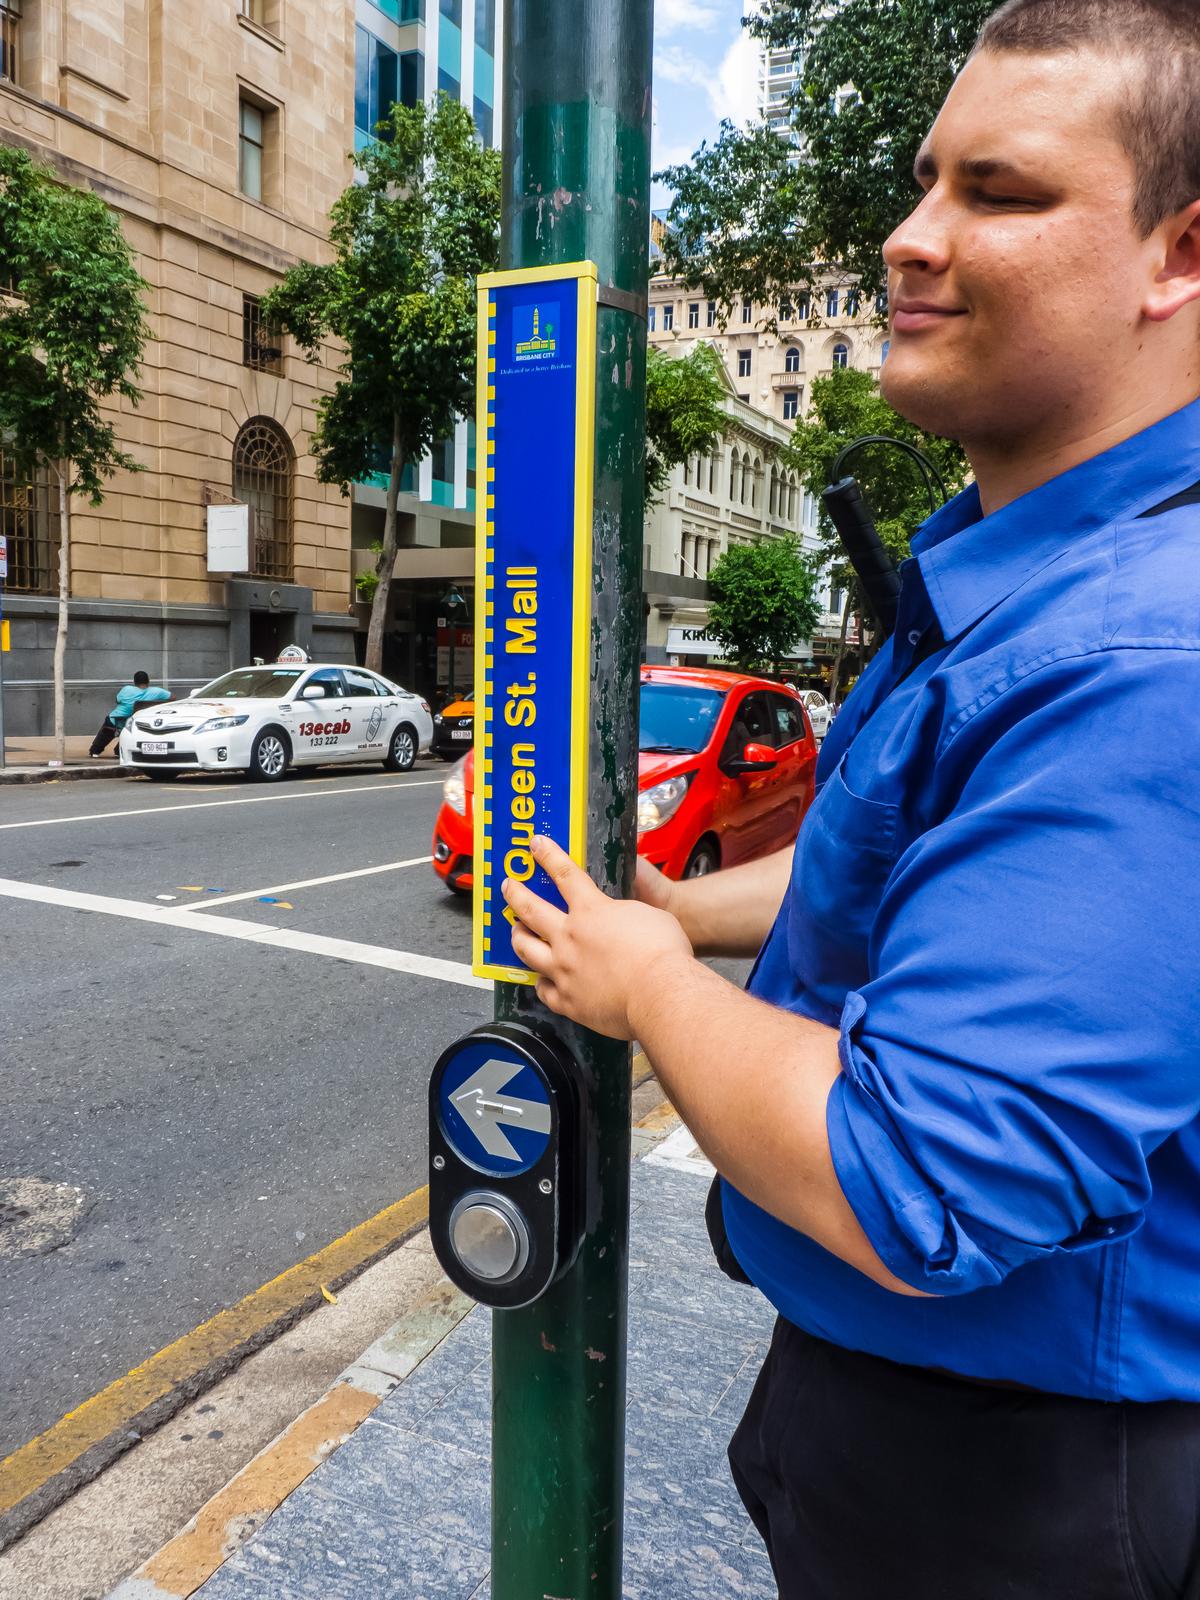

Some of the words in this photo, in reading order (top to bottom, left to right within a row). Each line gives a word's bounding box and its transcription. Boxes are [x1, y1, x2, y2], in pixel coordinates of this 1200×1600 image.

[515, 353, 542, 361] BRISBANE
[505, 566, 538, 654] Mall
[504, 671, 537, 727] St.
[299, 719, 351, 736] 13ecab
[310, 736, 323, 747] 133
[325, 736, 339, 745] 222
[503, 742, 537, 882] Queen
